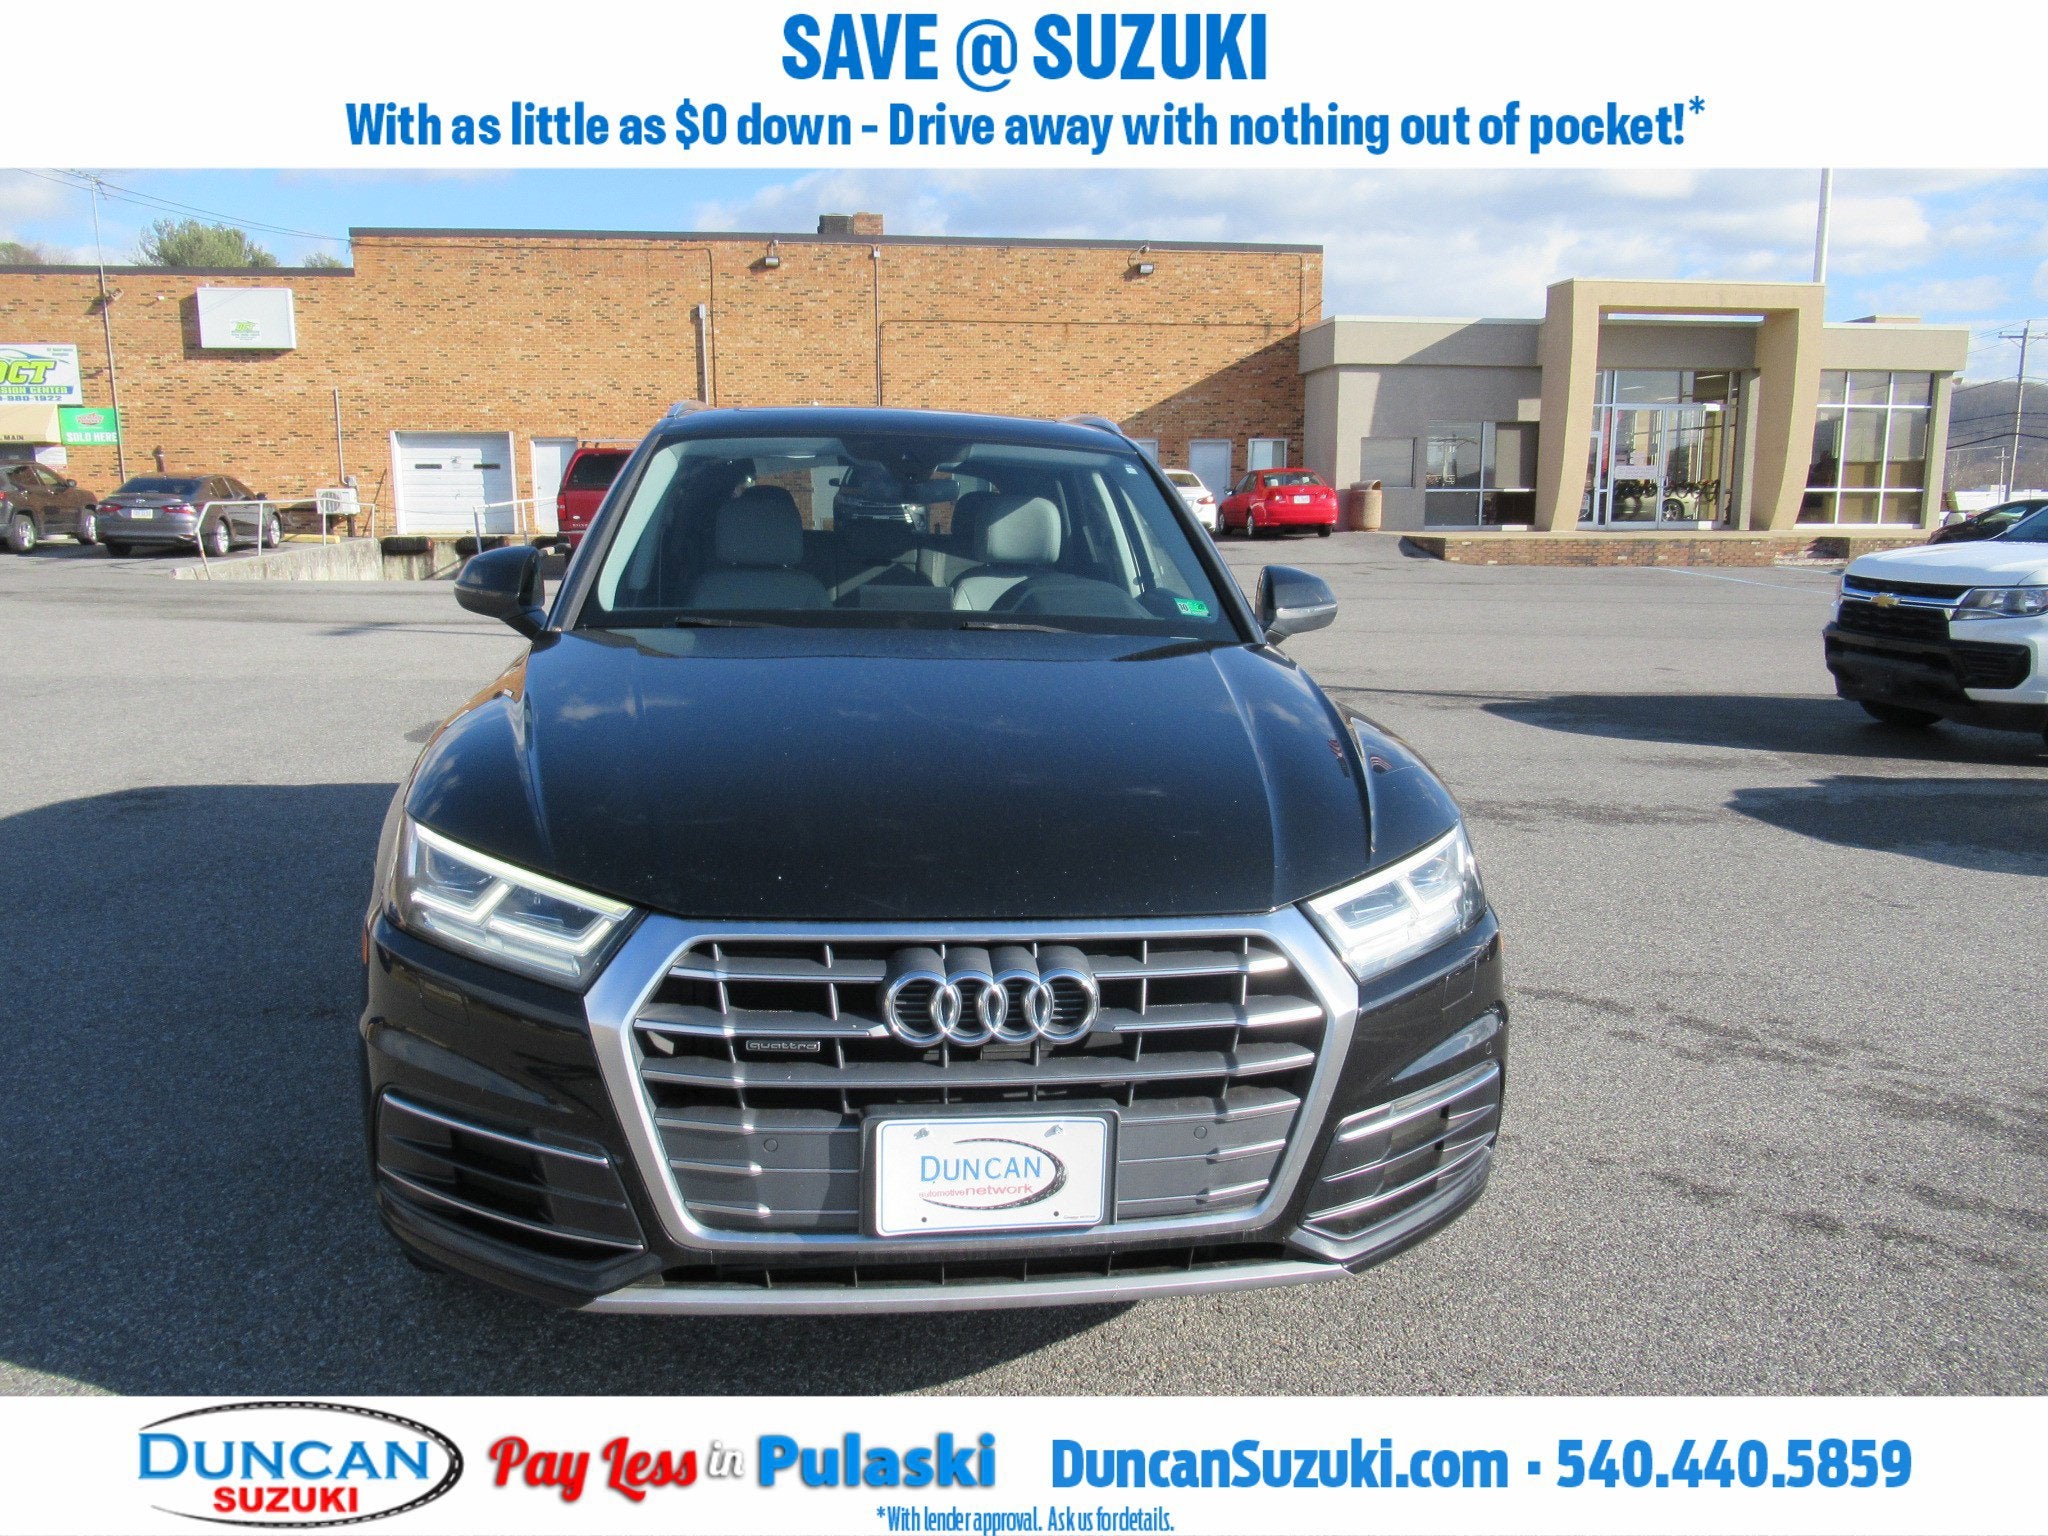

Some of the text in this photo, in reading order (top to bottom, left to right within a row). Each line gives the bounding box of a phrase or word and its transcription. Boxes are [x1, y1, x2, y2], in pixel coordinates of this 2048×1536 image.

[30, 386, 68, 394] CENTER
[66, 432, 118, 442] SOLD HERE
[748, 1042, 818, 1050] quattro
[920, 1155, 1042, 1182] DUNCAN
